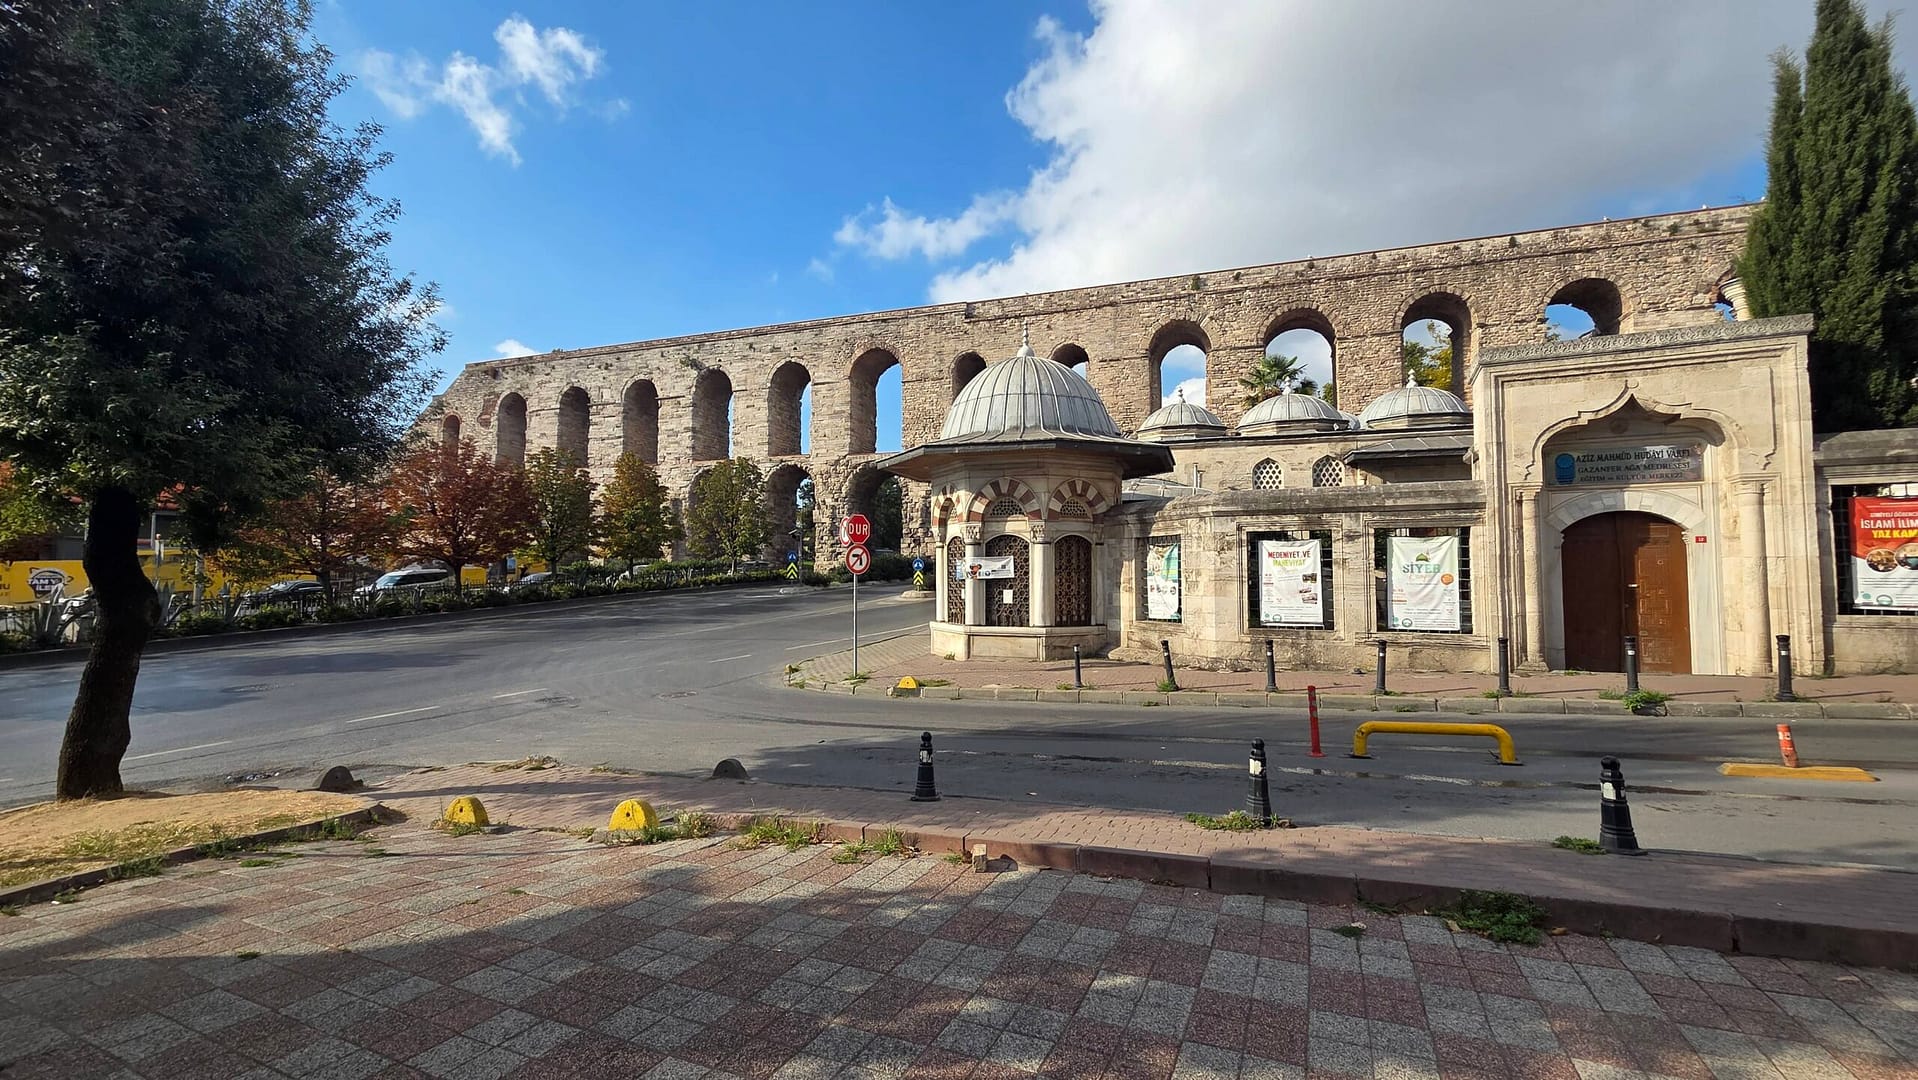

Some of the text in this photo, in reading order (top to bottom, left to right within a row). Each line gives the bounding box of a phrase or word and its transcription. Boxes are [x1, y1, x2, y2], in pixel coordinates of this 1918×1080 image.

[1578, 465, 1622, 474] GAZANFER
[1861, 518, 1895, 528] İSLAMİ
[848, 523, 868, 536] DUR
[1872, 529, 1891, 538] YAZ
[1302, 550, 1311, 558] VE
